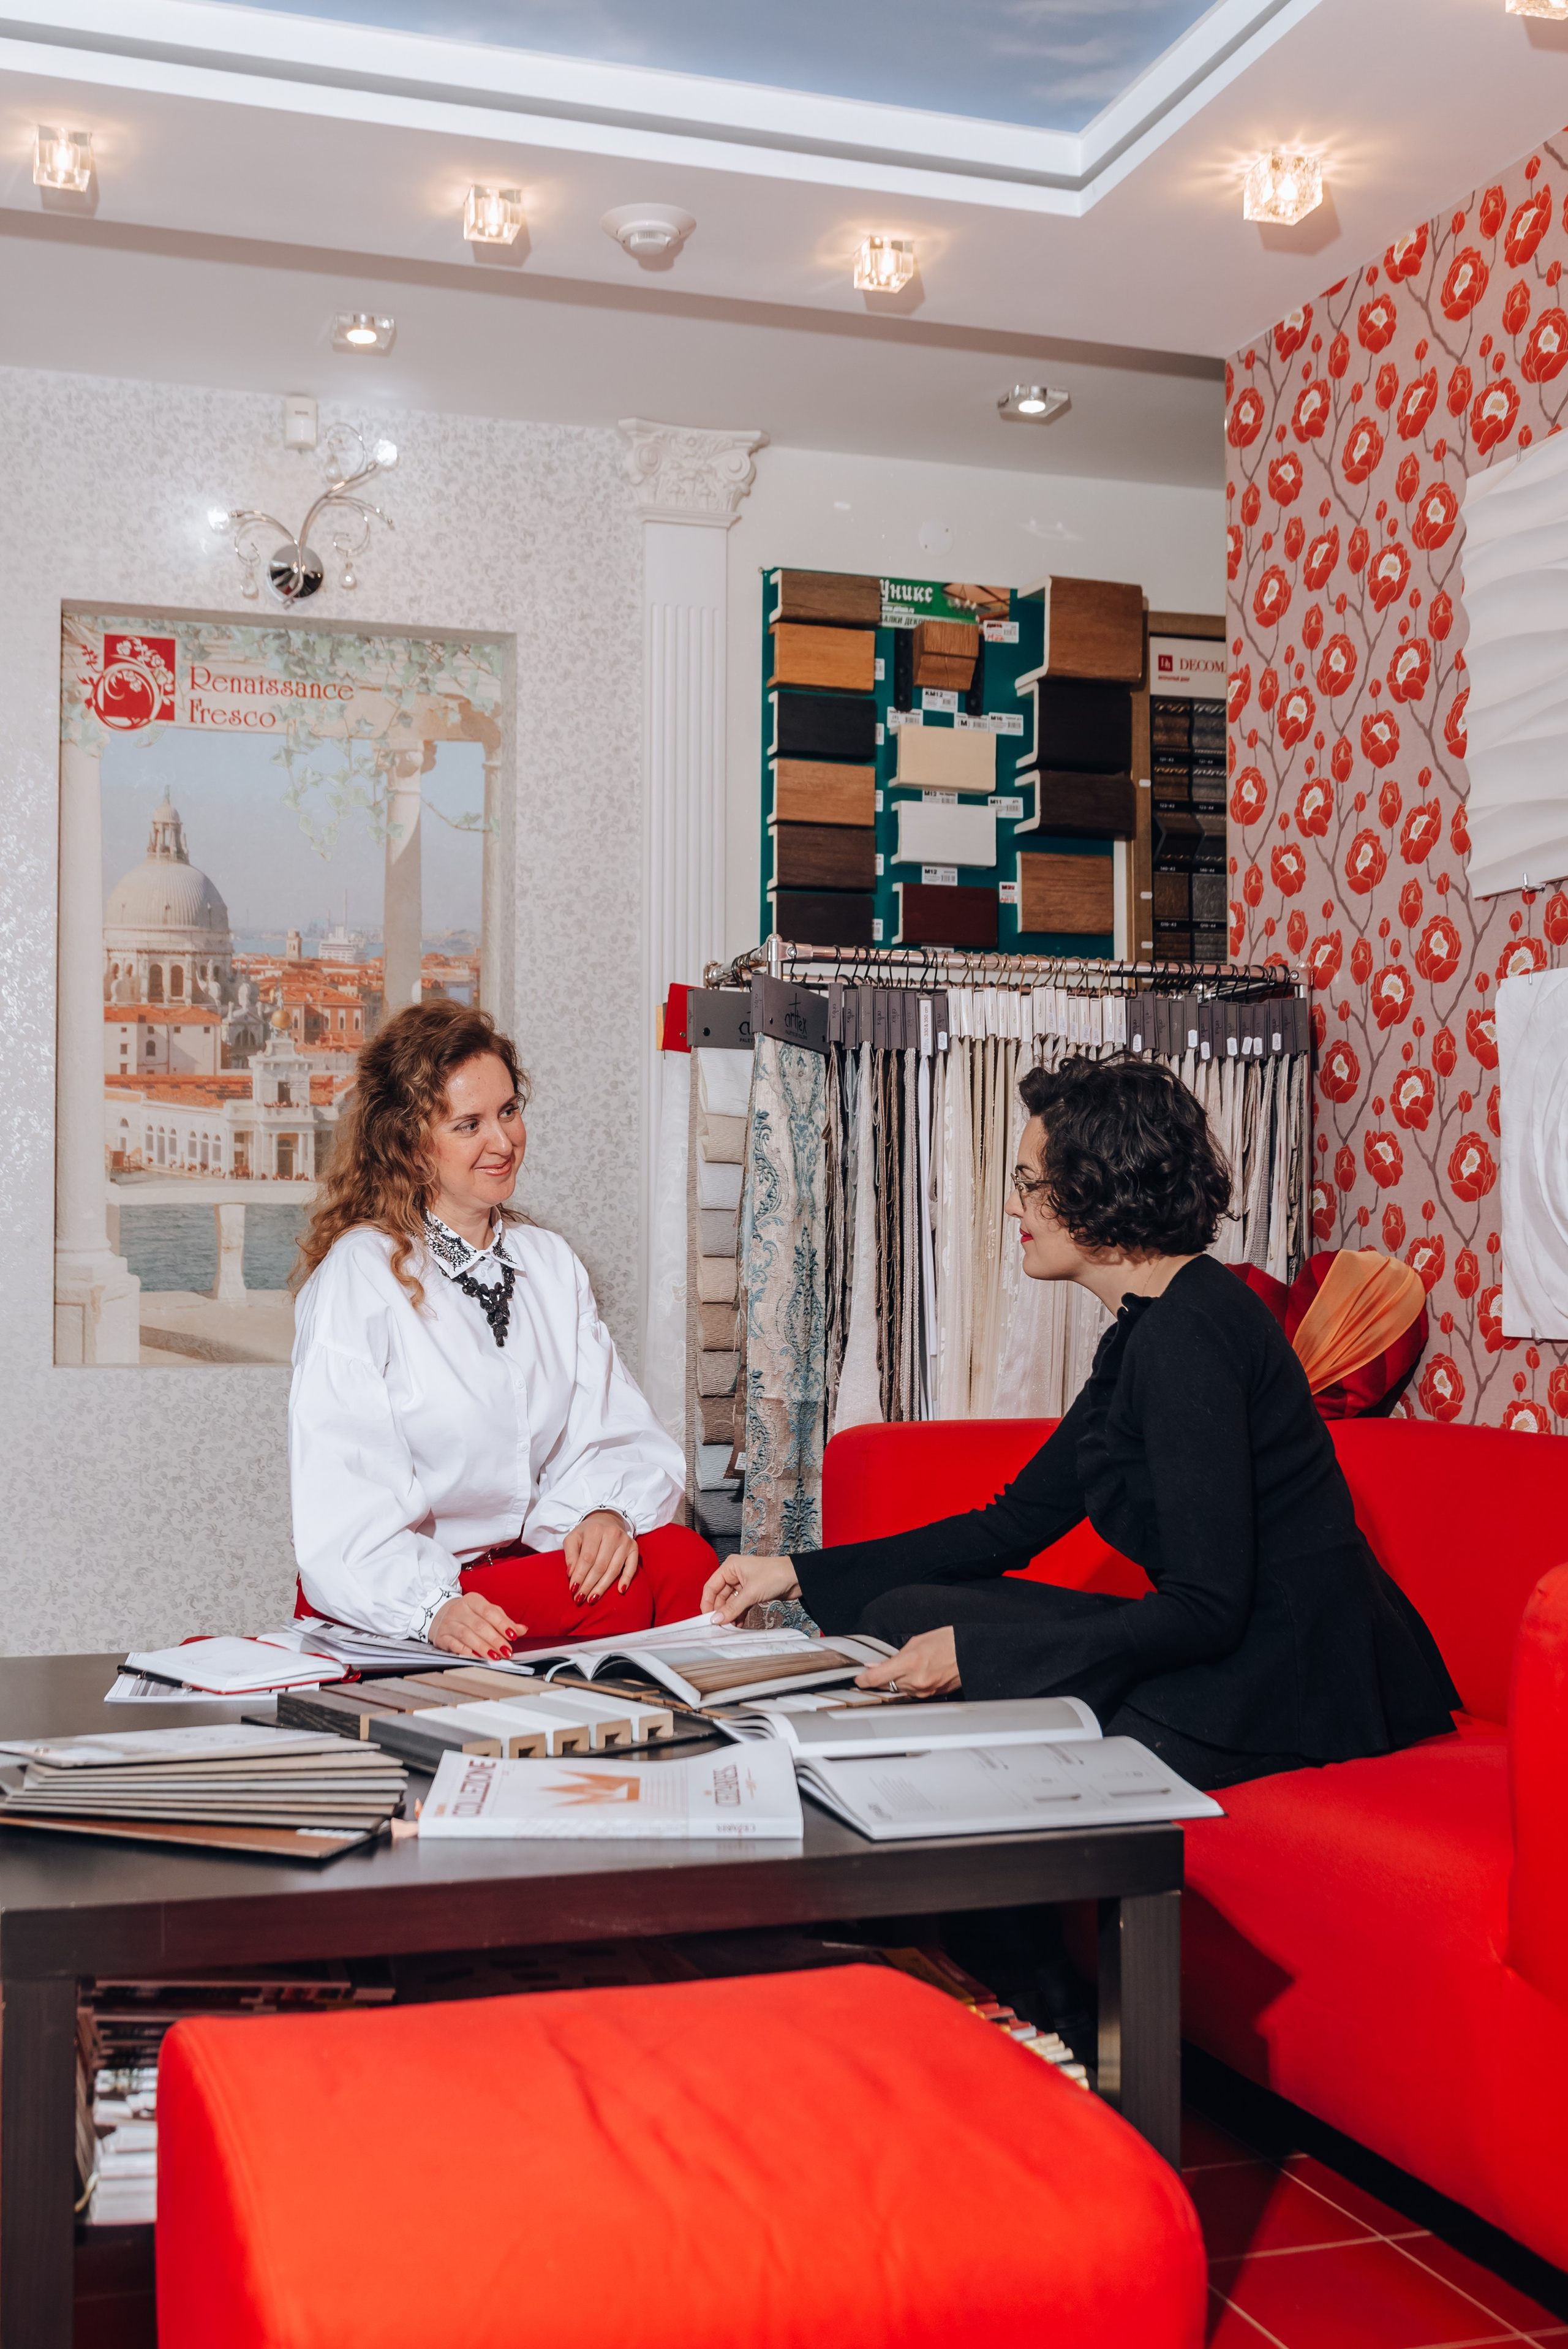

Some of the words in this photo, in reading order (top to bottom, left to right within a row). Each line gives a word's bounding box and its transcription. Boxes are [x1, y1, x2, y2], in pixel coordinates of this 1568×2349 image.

[880, 579, 933, 603] Уникс
[1180, 658, 1226, 673] DECOM
[189, 666, 354, 701] Renaissance
[189, 698, 276, 728] Fresco
